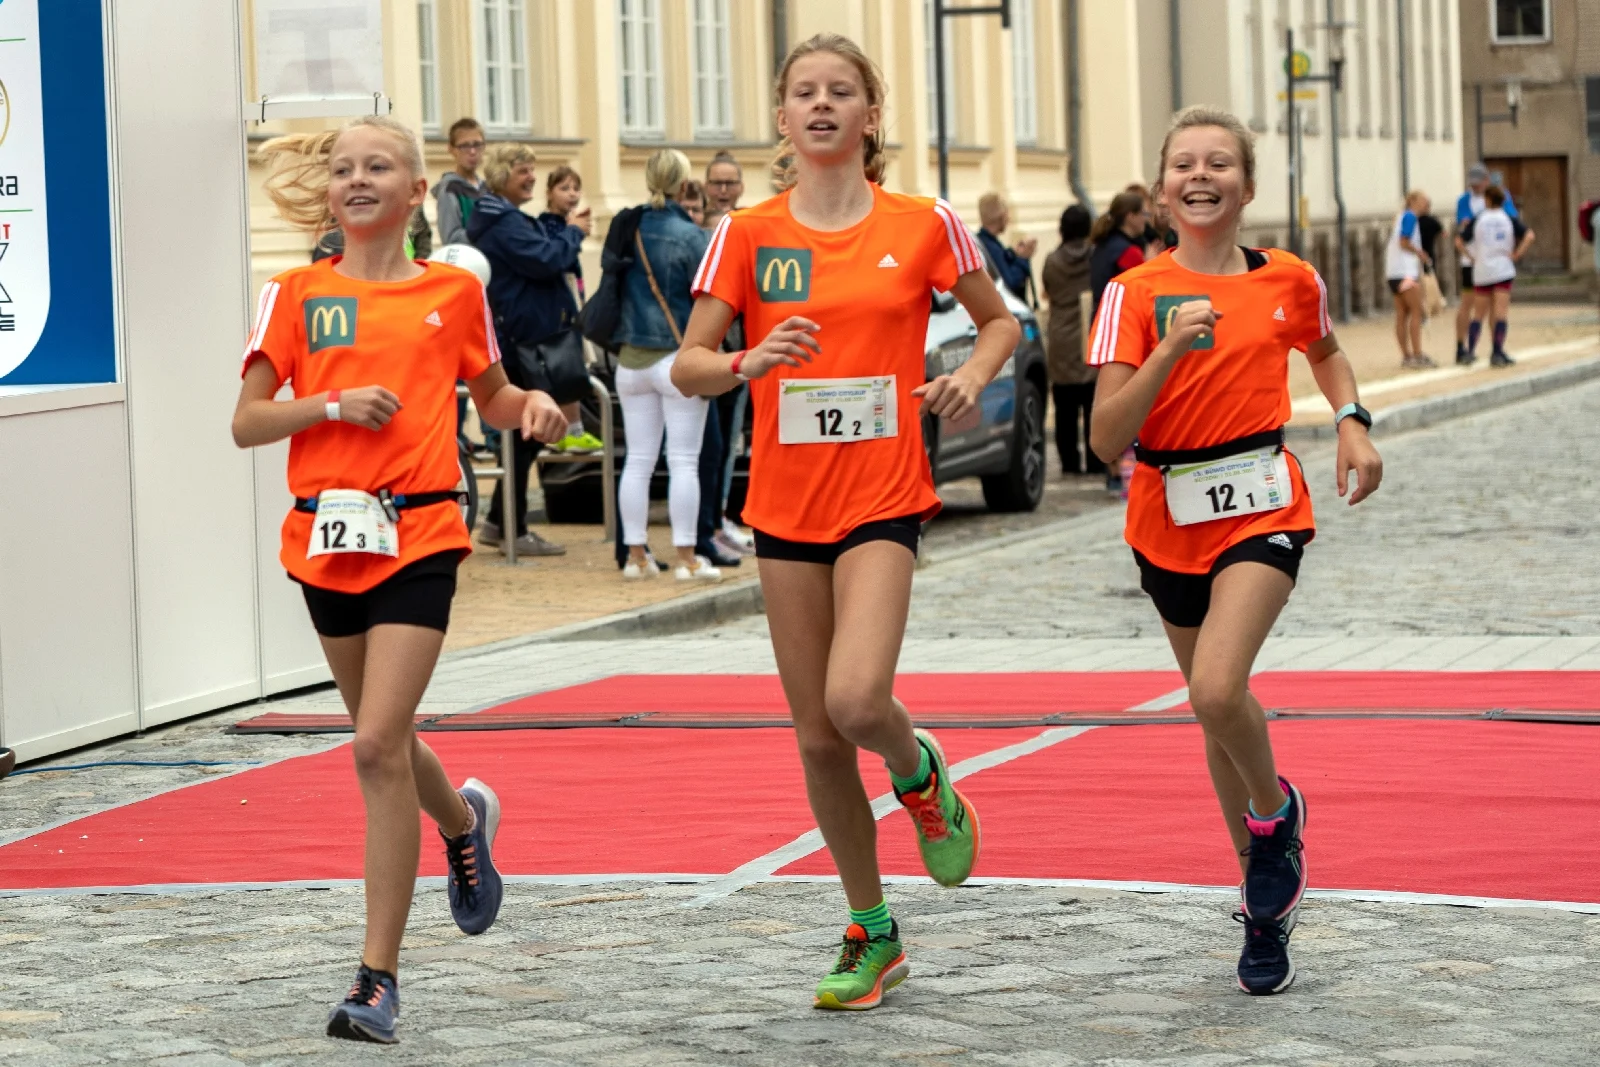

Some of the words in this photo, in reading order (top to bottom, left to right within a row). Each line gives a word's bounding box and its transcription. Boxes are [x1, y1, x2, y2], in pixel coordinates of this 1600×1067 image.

[815, 408, 843, 436] 12
[852, 420, 862, 436] 2
[1205, 483, 1238, 514] 12
[1245, 492, 1255, 508] 1
[320, 521, 347, 549] 12
[357, 533, 366, 549] 3
[1267, 537, 1293, 550] adidas
